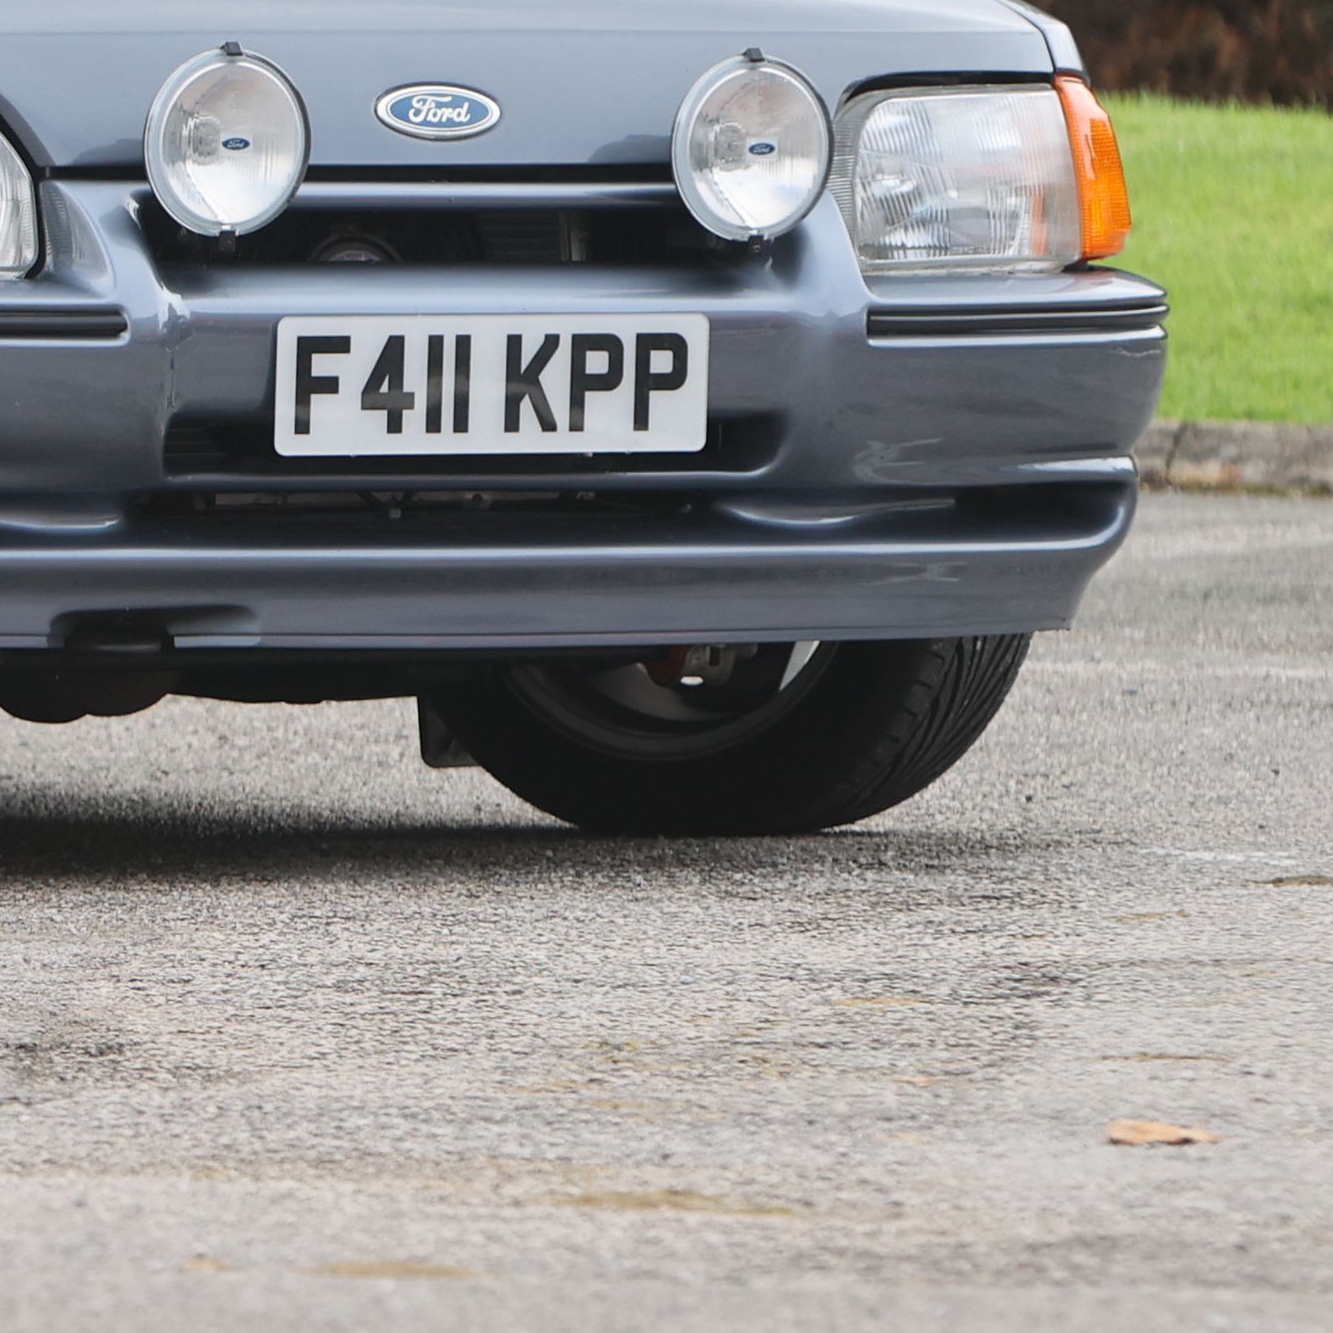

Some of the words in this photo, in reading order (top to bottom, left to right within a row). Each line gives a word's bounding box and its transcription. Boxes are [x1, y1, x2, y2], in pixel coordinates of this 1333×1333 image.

[408, 95, 471, 123] Ford
[294, 334, 472, 435] F411
[503, 332, 689, 433] KPP
